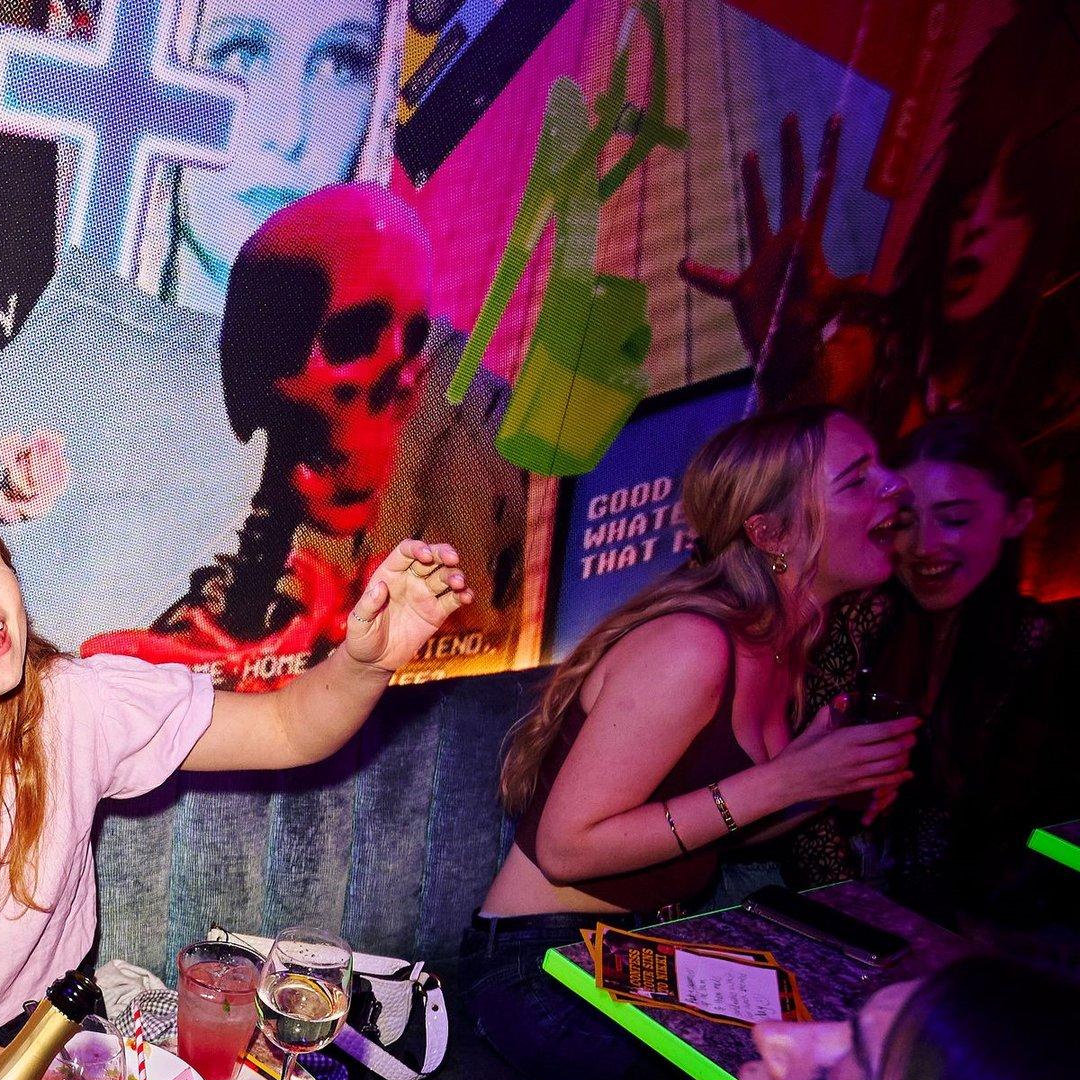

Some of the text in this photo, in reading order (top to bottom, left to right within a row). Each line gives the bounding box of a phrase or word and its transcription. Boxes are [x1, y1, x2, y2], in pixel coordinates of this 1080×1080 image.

[588, 476, 672, 521] GOOD
[581, 537, 659, 580] THAT
[242, 652, 312, 681] HOME
